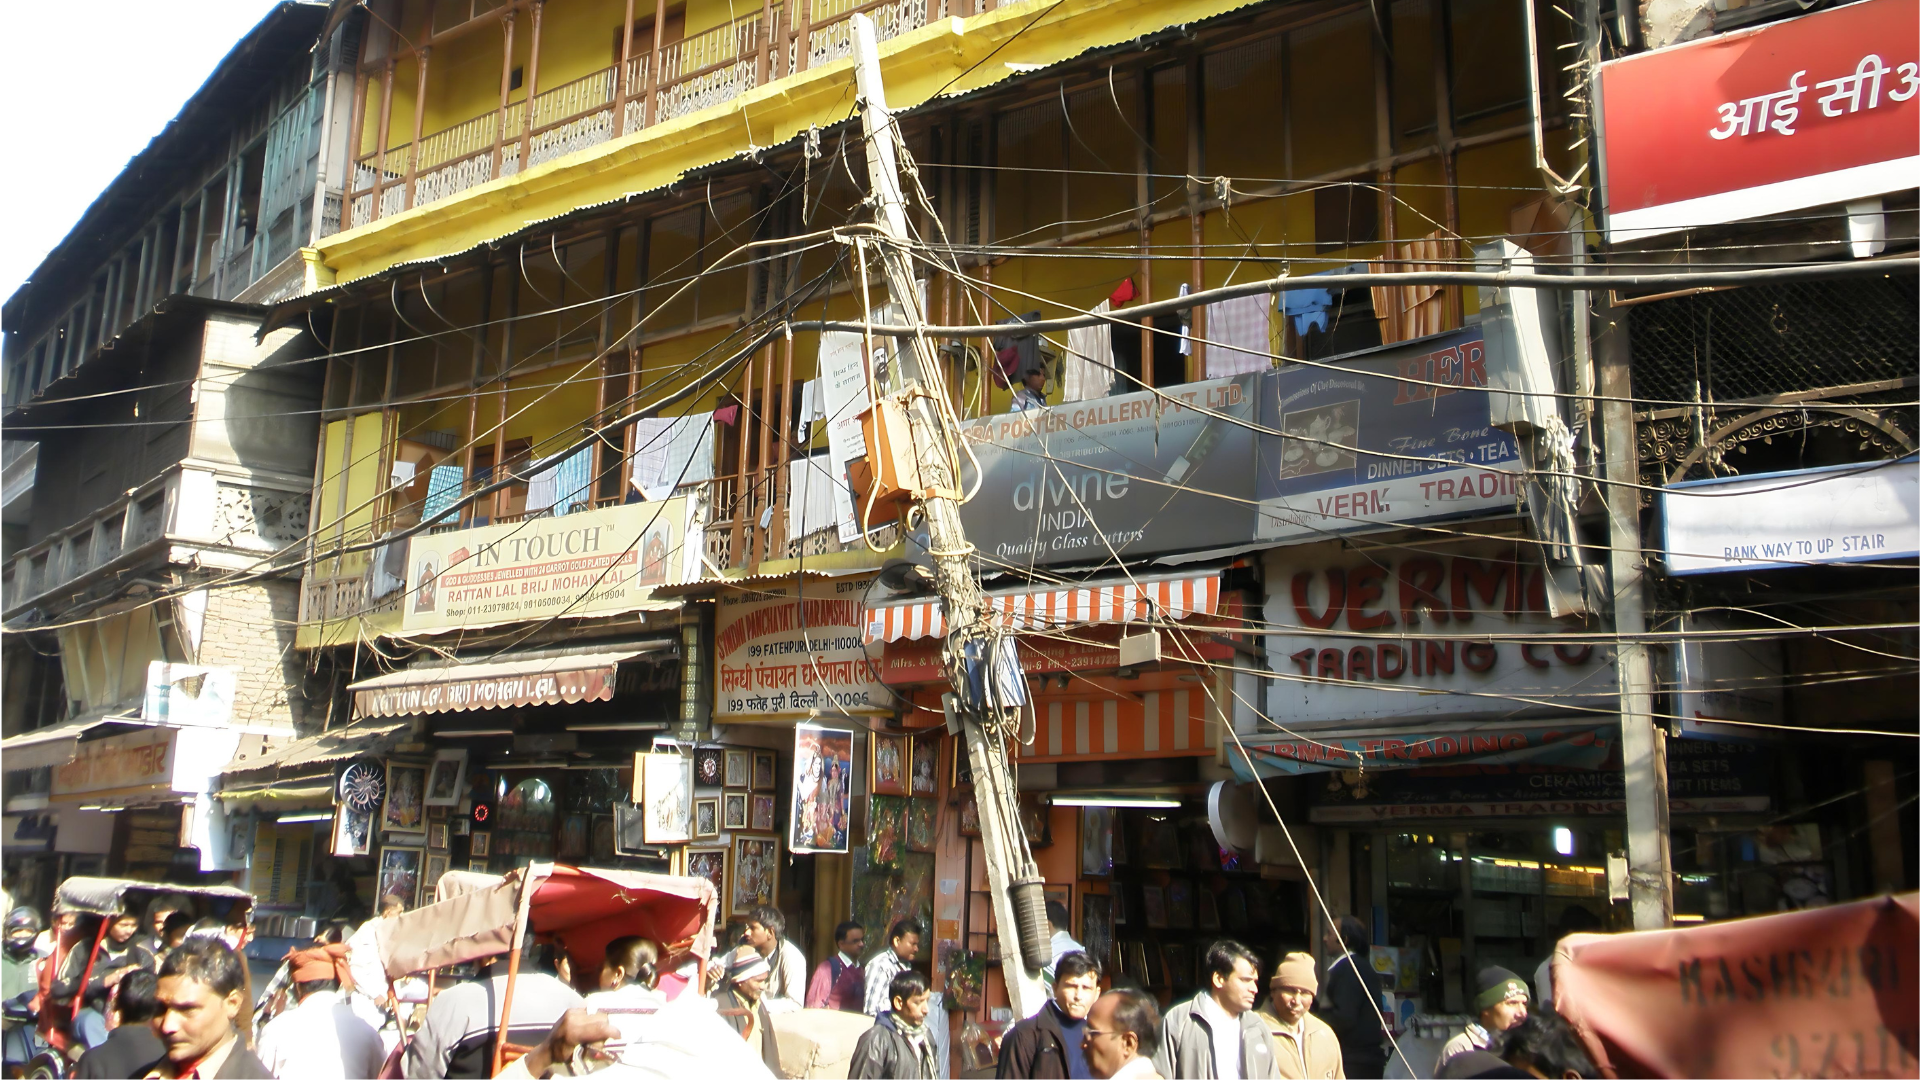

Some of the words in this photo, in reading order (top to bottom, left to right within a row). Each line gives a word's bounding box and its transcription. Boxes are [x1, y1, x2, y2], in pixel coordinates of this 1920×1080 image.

[1710, 70, 1808, 140] आई
[1815, 54, 1891, 118] सी
[999, 412, 1068, 441] POSTER
[1072, 398, 1155, 428] GALLERY
[1367, 459, 1423, 480] DINNER
[1478, 441, 1509, 462] TEA
[1042, 508, 1095, 533] INDIA
[475, 540, 501, 567] IN
[509, 525, 602, 563] TOUCH
[996, 530, 1048, 560] Quality
[1051, 532, 1088, 553] Glass
[1724, 545, 1759, 563] BANK
[1761, 542, 1793, 558] WAY
[1796, 540, 1813, 556] TO
[1817, 538, 1834, 553] UP
[1842, 533, 1885, 551] STAIR
[523, 566, 538, 577] WITH
[587, 558, 610, 568] PLATED
[448, 586, 492, 603] RATTAN
[496, 583, 517, 598] LAL
[521, 579, 548, 595] BRIJ
[552, 573, 598, 592] MOHAN
[602, 569, 626, 585] LAL
[446, 608, 466, 618] Shop:
[747, 603, 795, 640] PANCHAYAT
[755, 660, 798, 689] पंचायत
[1289, 638, 1497, 683] TRADING
[1358, 733, 1528, 760] TRADING
[1667, 742, 1713, 755] INNER
[1668, 760, 1688, 774] EA
[1669, 778, 1693, 792] IFT
